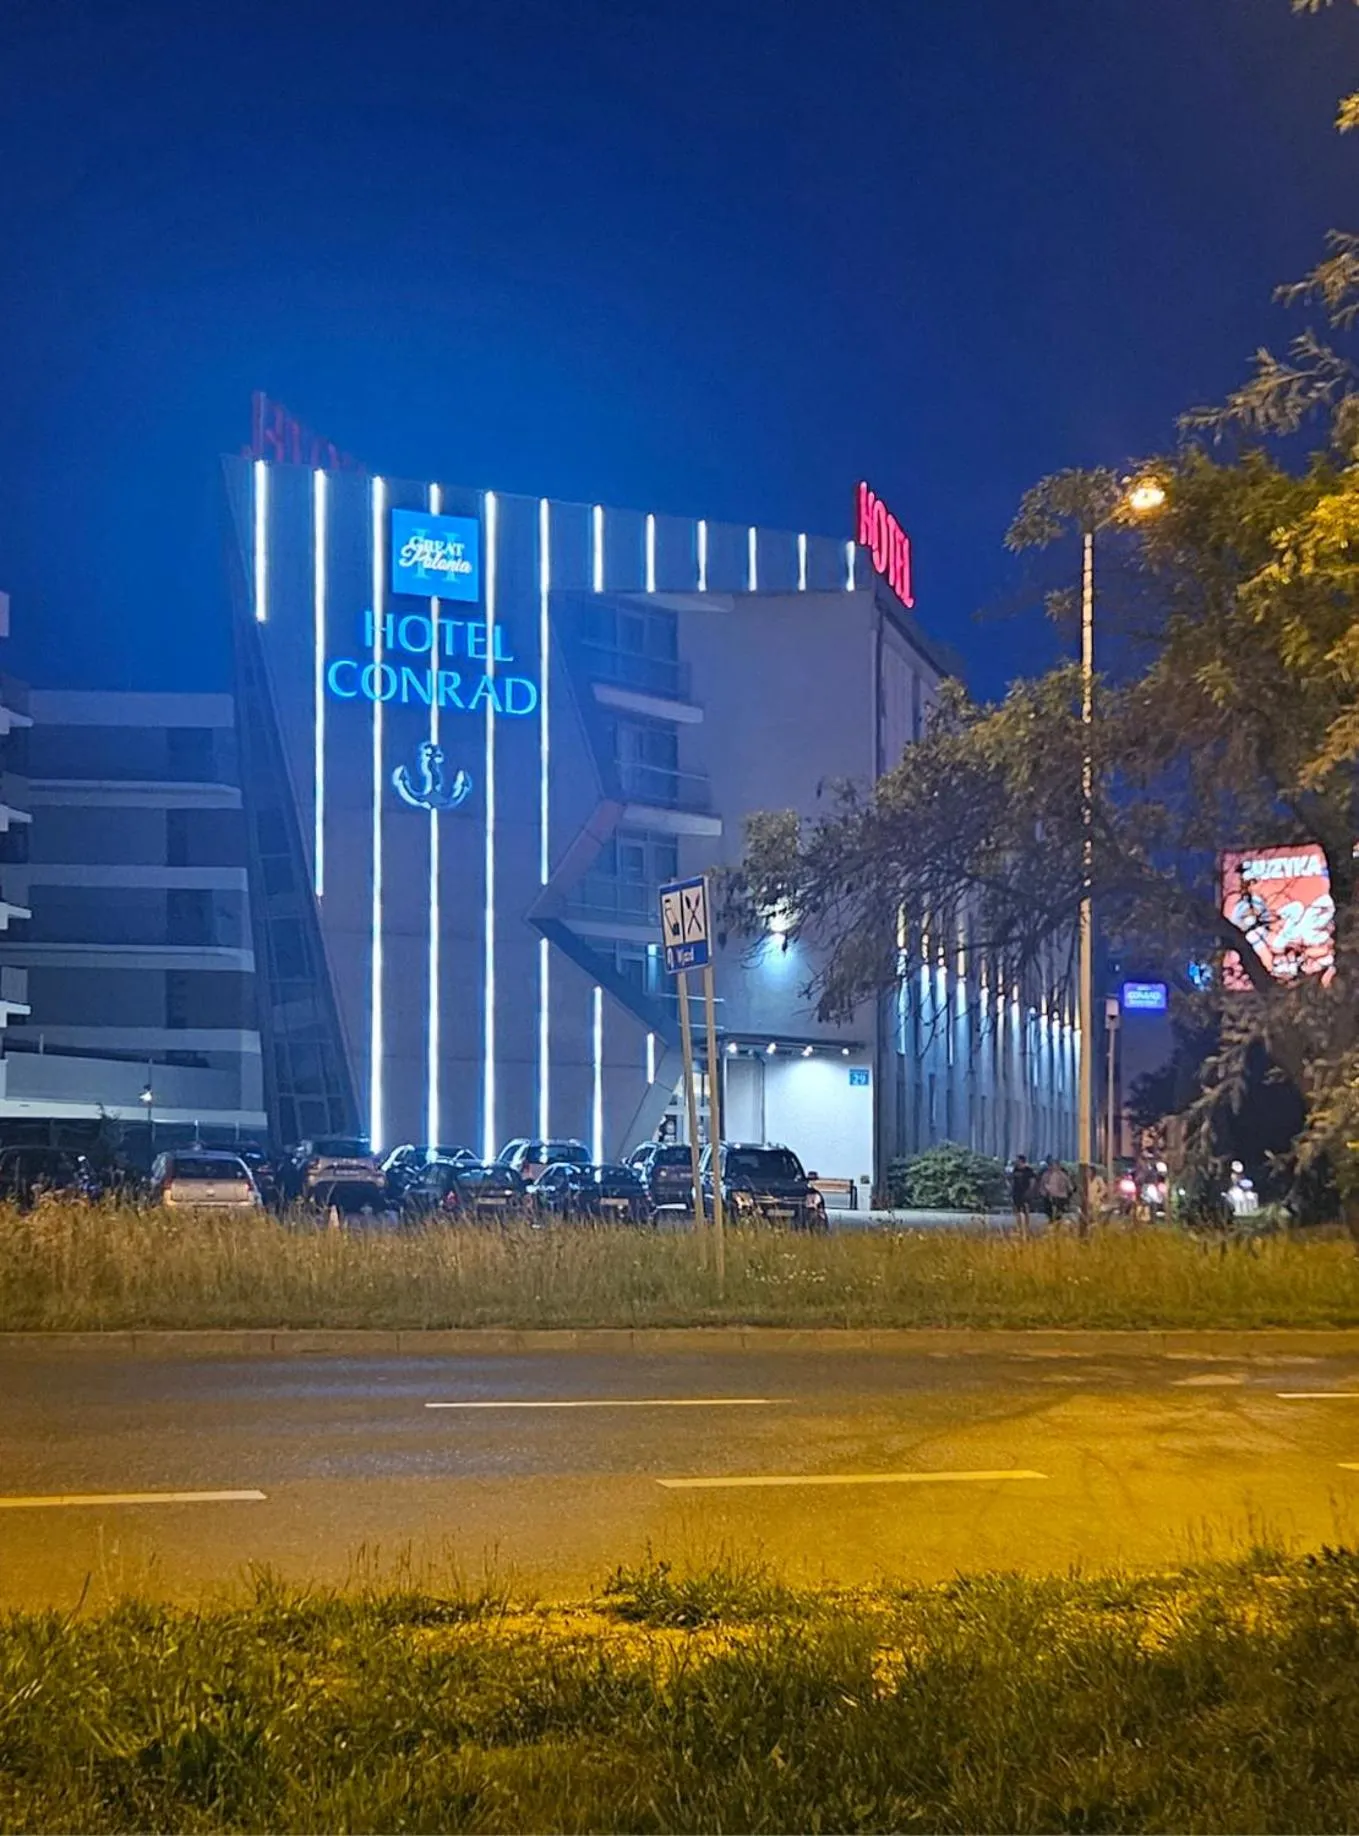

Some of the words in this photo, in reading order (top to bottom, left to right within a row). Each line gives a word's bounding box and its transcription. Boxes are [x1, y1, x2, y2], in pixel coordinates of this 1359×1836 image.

[409, 536, 465, 556] GREAT
[860, 481, 914, 608] HOTEL
[364, 611, 513, 661] HOTEL
[328, 660, 537, 714] CONRAD
